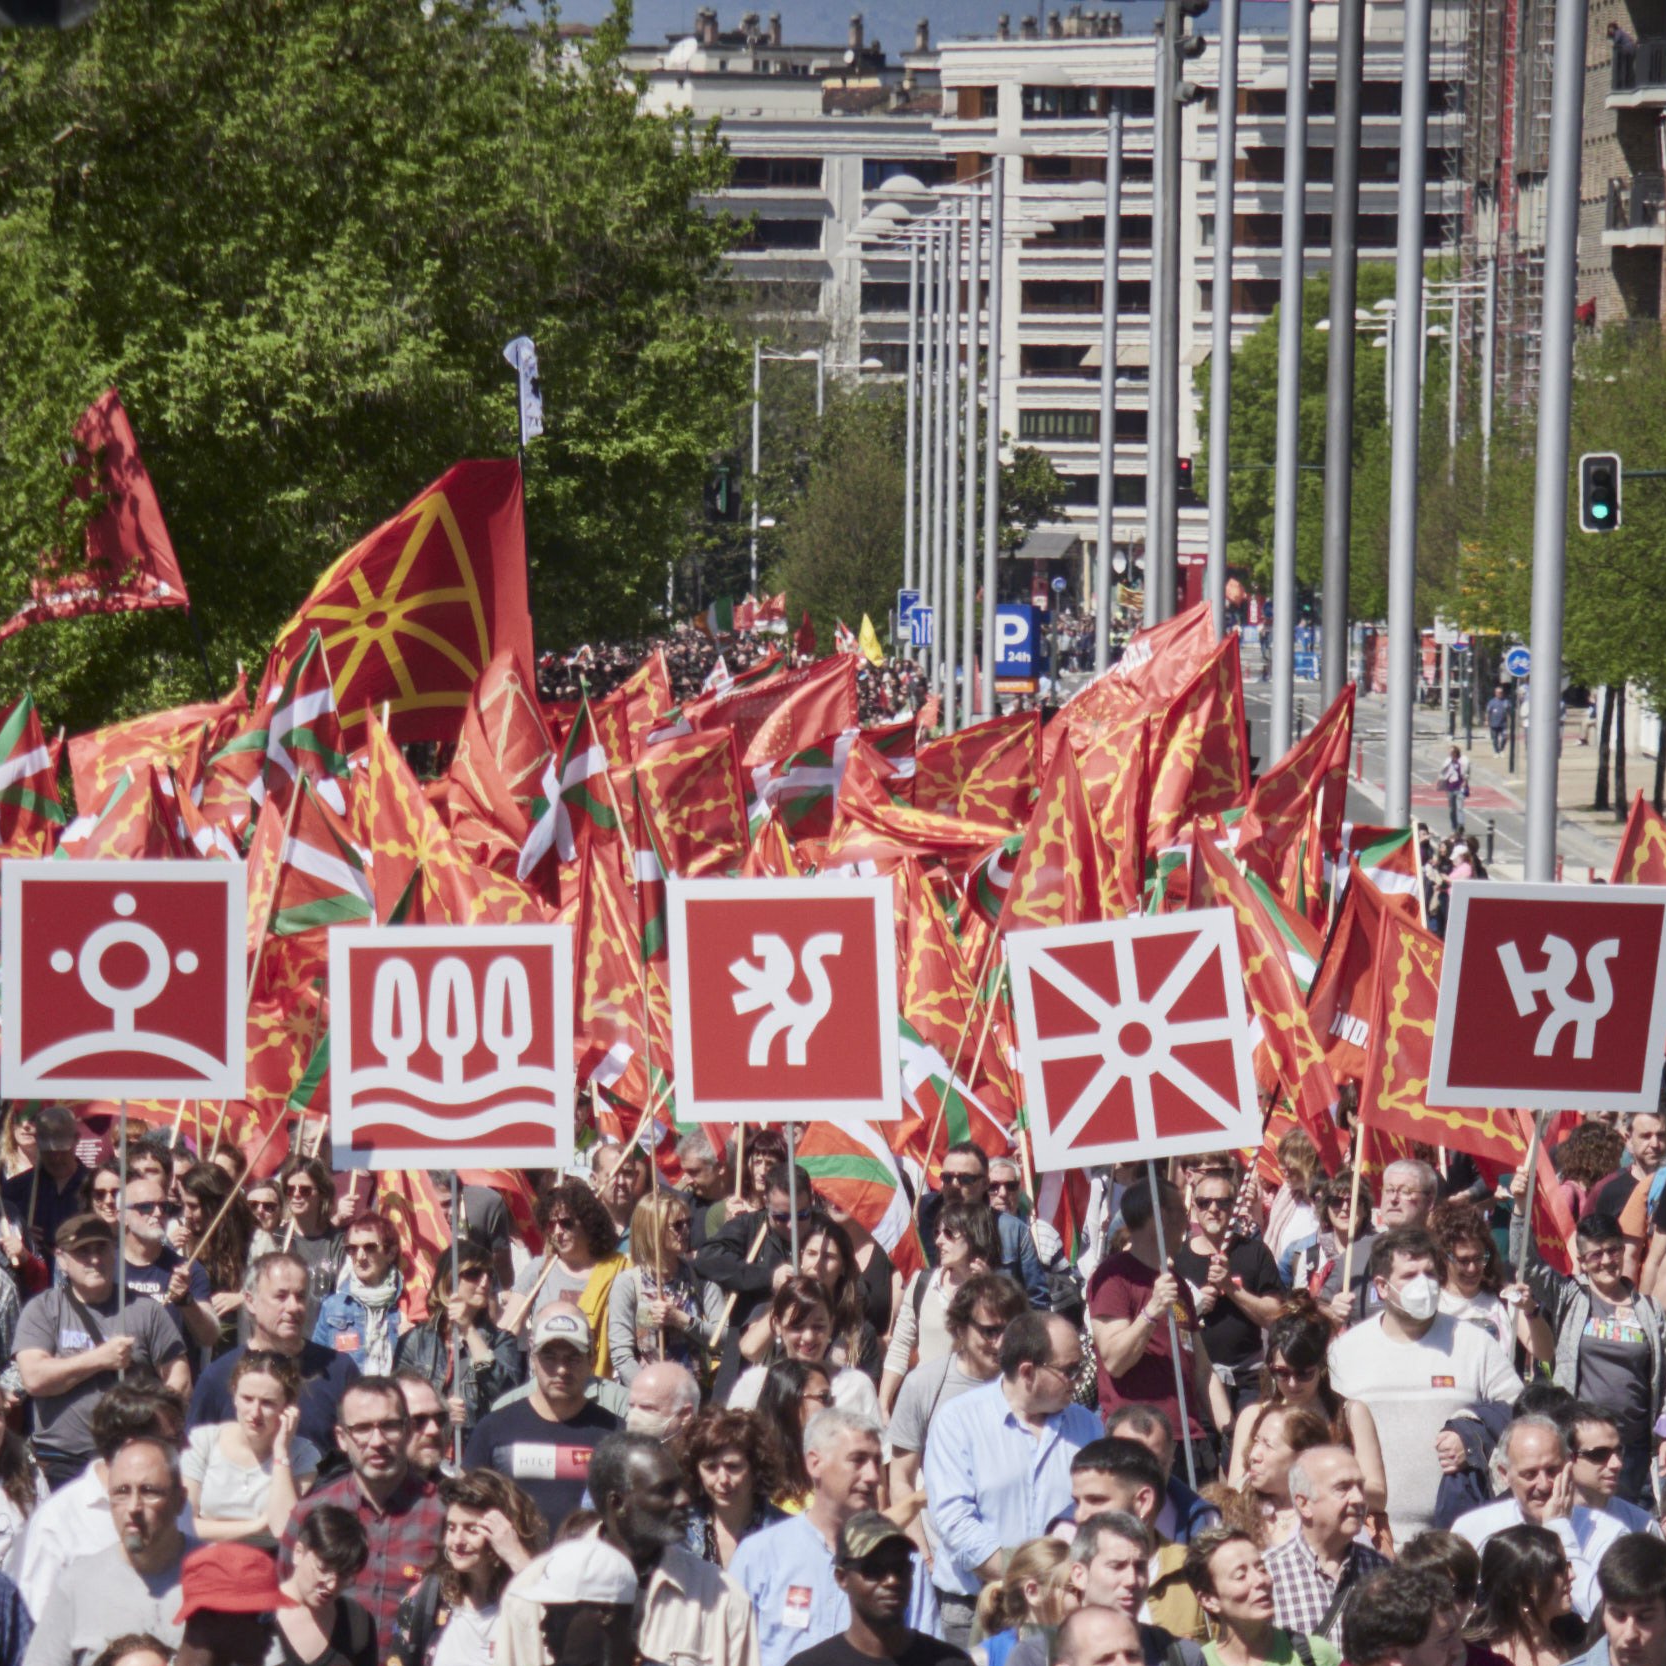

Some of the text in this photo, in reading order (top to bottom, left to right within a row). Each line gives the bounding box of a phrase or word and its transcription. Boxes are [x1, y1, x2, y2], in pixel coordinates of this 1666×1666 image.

[995, 614, 1030, 662] P
[1007, 650, 1032, 663] 24h
[1328, 1008, 1370, 1052] IND
